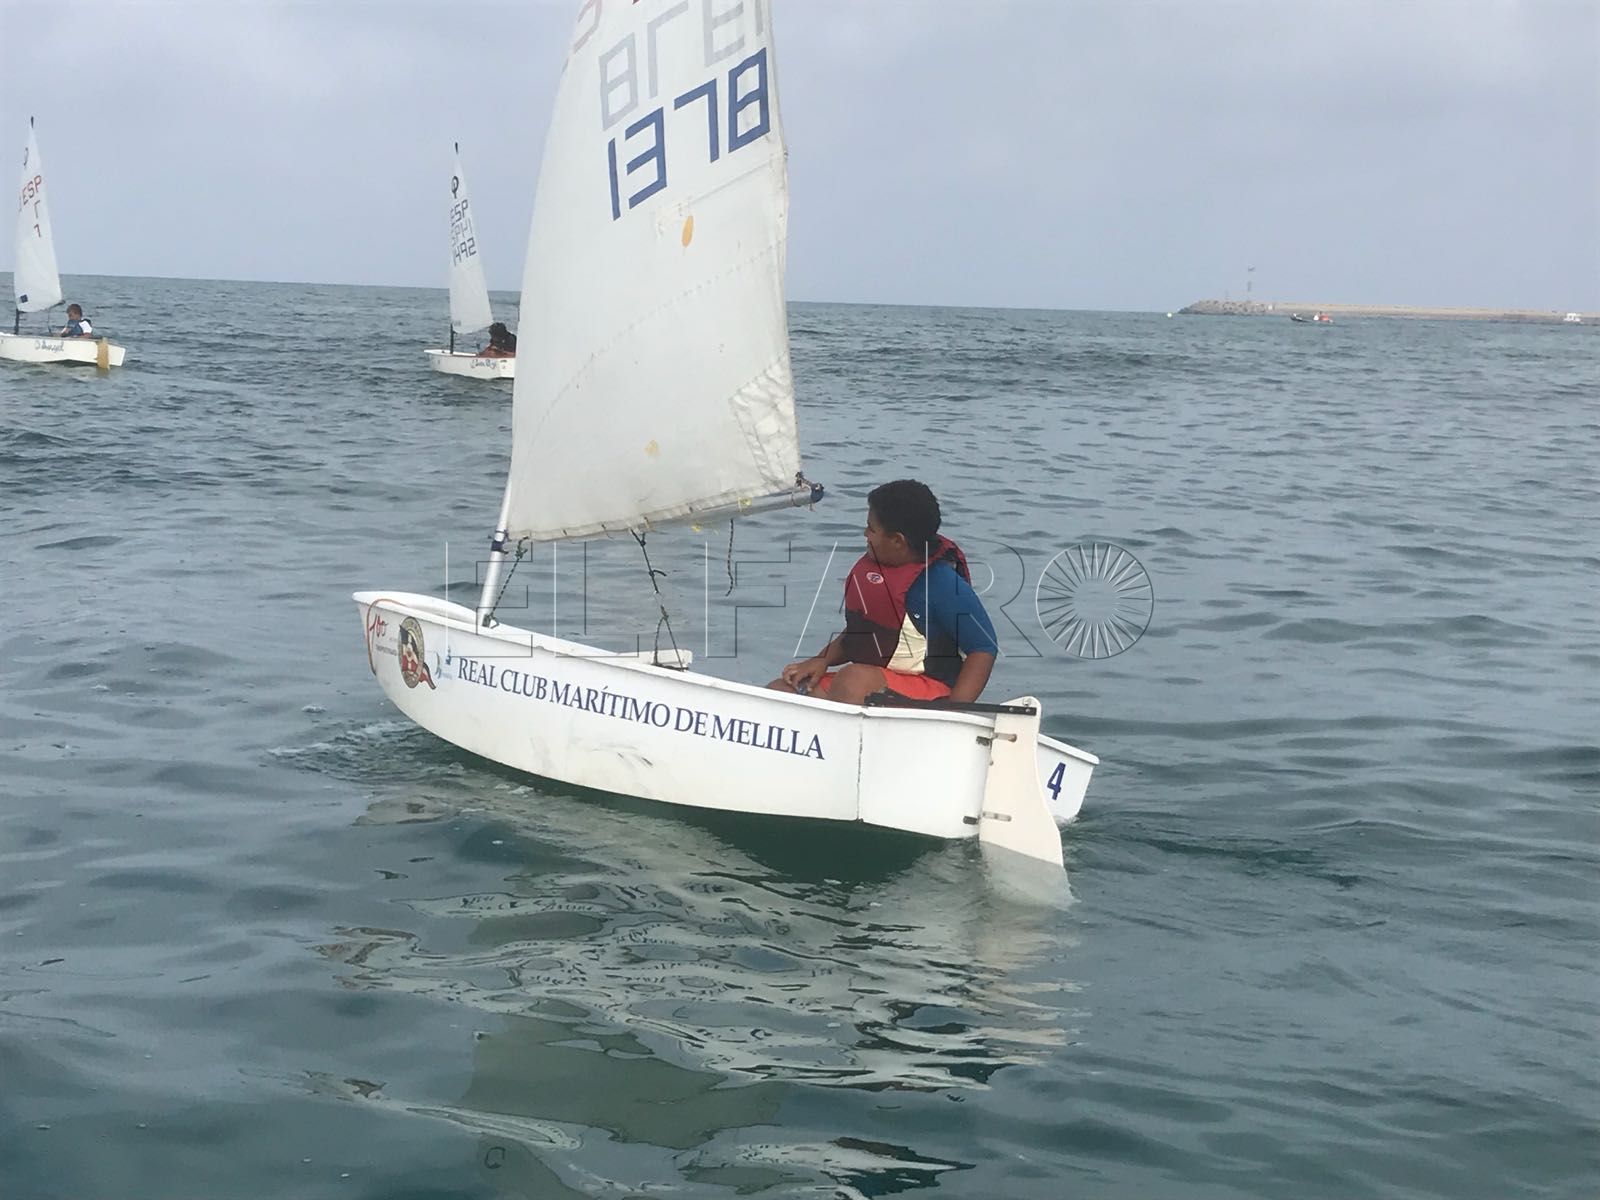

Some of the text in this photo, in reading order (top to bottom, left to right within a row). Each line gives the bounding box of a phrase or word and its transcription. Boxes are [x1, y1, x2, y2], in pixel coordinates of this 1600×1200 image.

[607, 46, 771, 221] 1378
[22, 174, 42, 205] ESP
[458, 657, 825, 760] REAL CLUB MARÍTIMO DE MELILLA
[1046, 762, 1067, 801] 4
